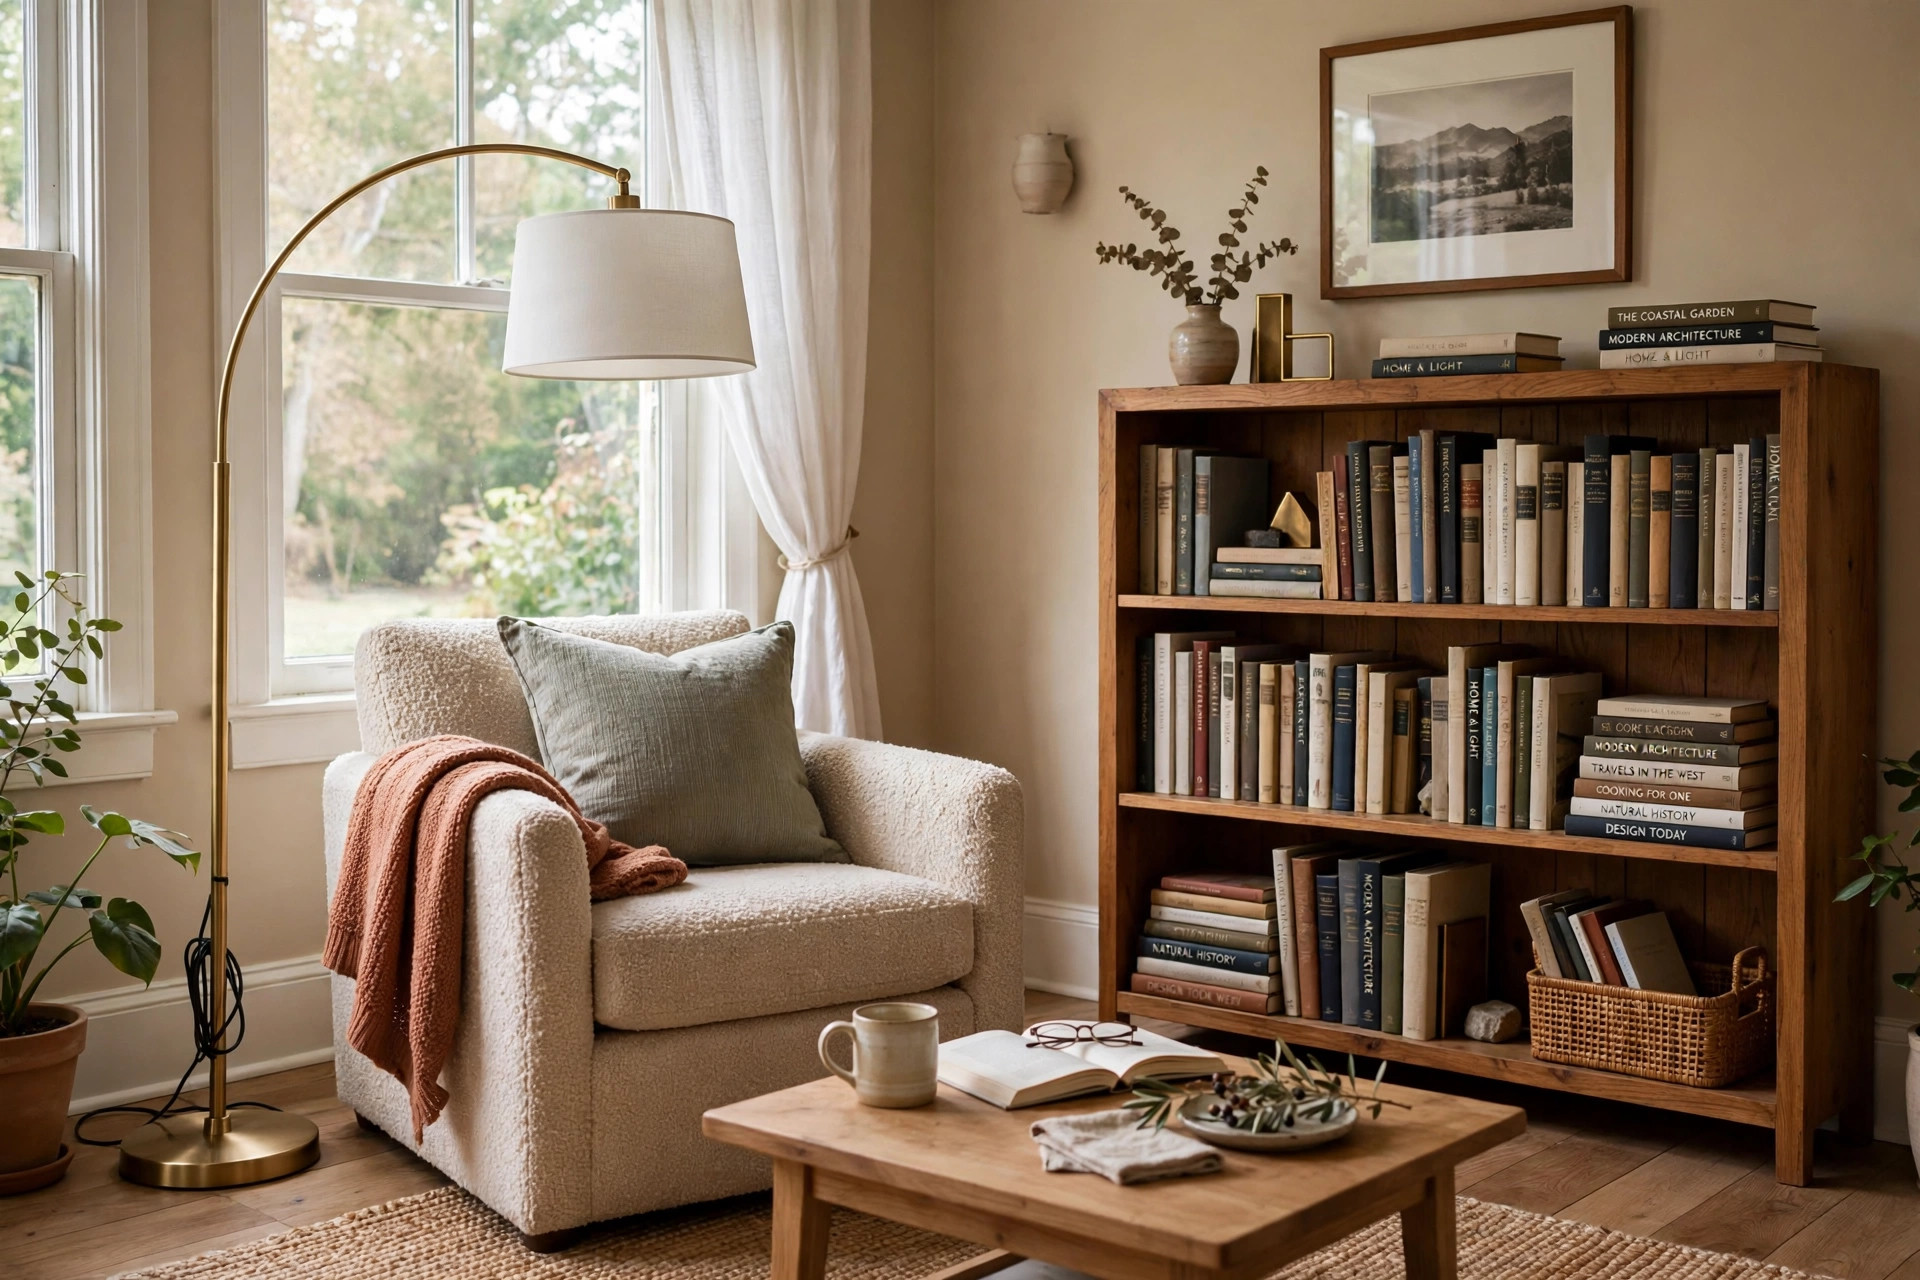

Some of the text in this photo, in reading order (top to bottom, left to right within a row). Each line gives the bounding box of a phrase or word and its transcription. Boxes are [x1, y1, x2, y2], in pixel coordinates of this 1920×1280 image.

[1617, 307, 1735, 322] THE COASTAL GARDEN
[1608, 328, 1742, 345] MODERN ARCHITECTURE
[1430, 361, 1464, 372] LIGHT
[1467, 681, 1480, 714] HOME
[1594, 741, 1718, 760] MODERN ARCHITECTURE
[1591, 763, 1706, 781] TRAVELS IN THE WEST
[1596, 785, 1692, 801] COOKING FOR ONE
[1600, 804, 1697, 821] NATURAL HISTORY
[1605, 823, 1687, 841] DESIGN TODAY
[1152, 943, 1237, 966] NATURAL HISTORY
